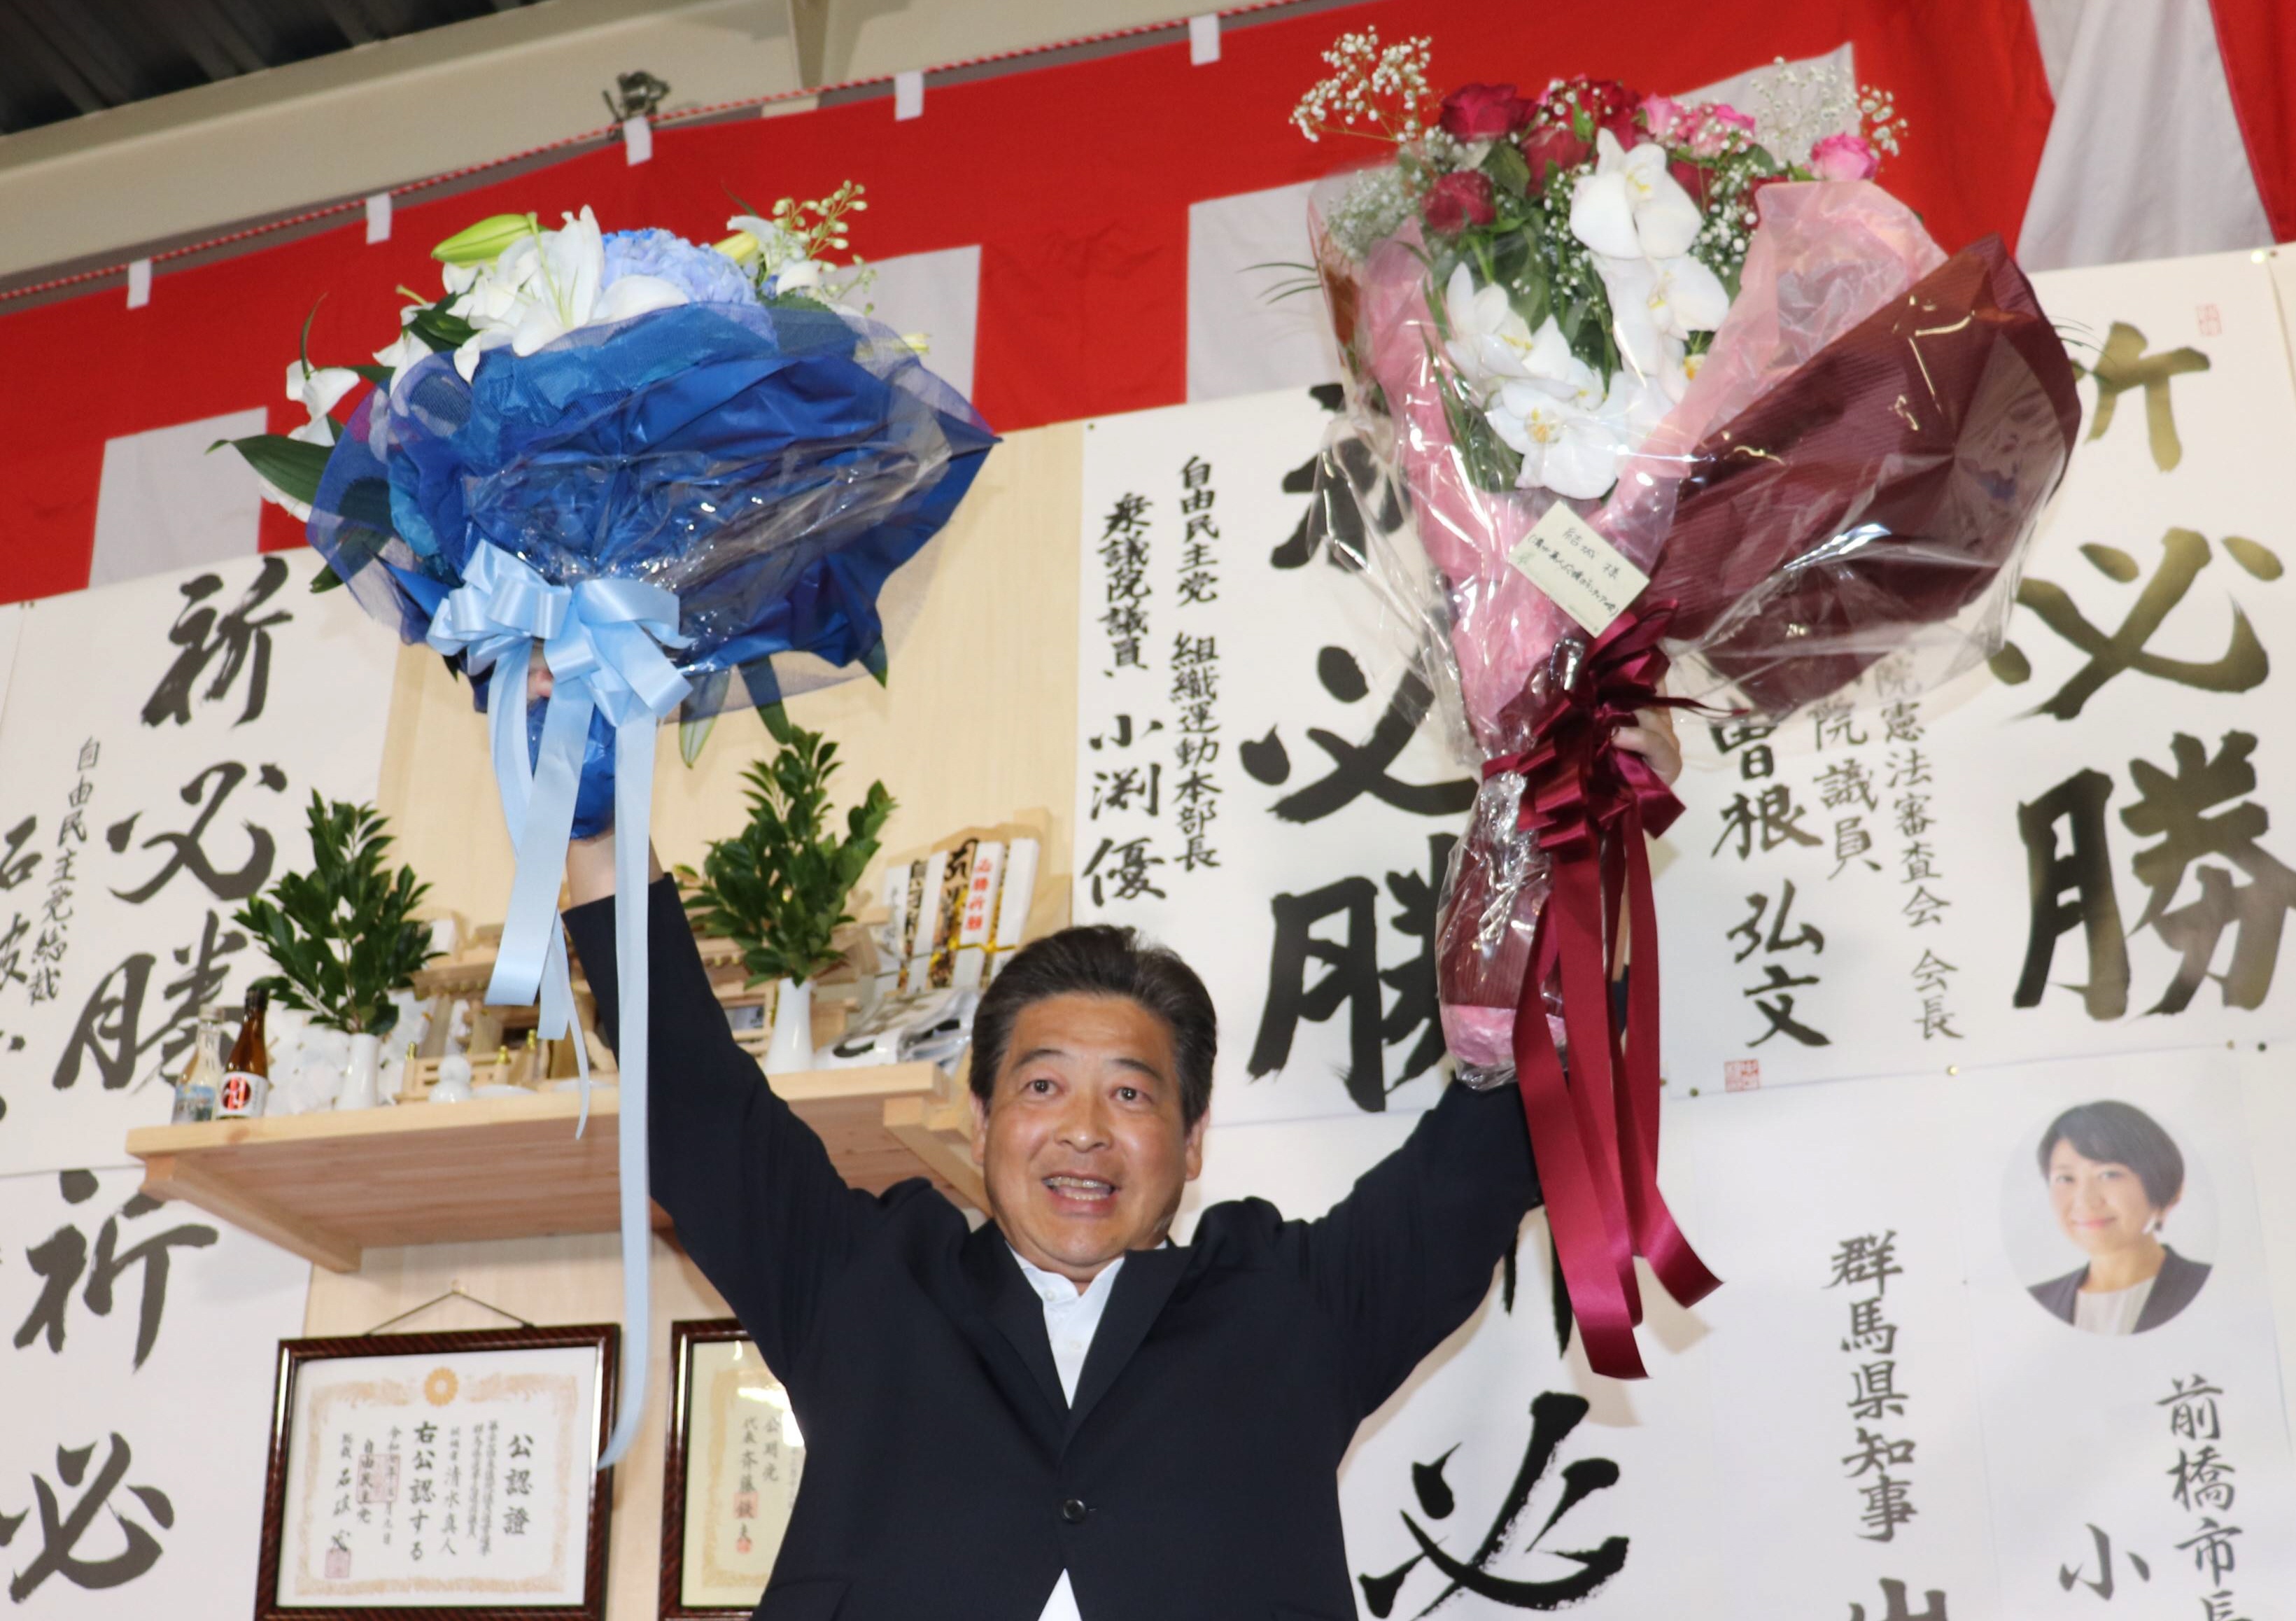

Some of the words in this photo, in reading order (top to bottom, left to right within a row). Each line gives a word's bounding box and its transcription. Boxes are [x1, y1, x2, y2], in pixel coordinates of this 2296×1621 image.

[1097, 491, 1155, 678] 衆議院議員
[1176, 454, 1219, 608] 自由民主党
[53, 557, 293, 1093] 祈必勝
[1082, 714, 1167, 908] 小渕優
[1169, 630, 1223, 872] 組織運動本部長
[30, 737, 99, 1005] 自由民主党総裁
[1725, 877, 1833, 1049] 弘文
[1910, 948, 1965, 1041] 会長
[0, 1168, 219, 1604] 祈必
[1820, 1229, 1919, 1544] 群馬県知事
[409, 1422, 438, 1562] 右公認する
[502, 1434, 535, 1535] 公認證
[2059, 1523, 2151, 1601] 小
